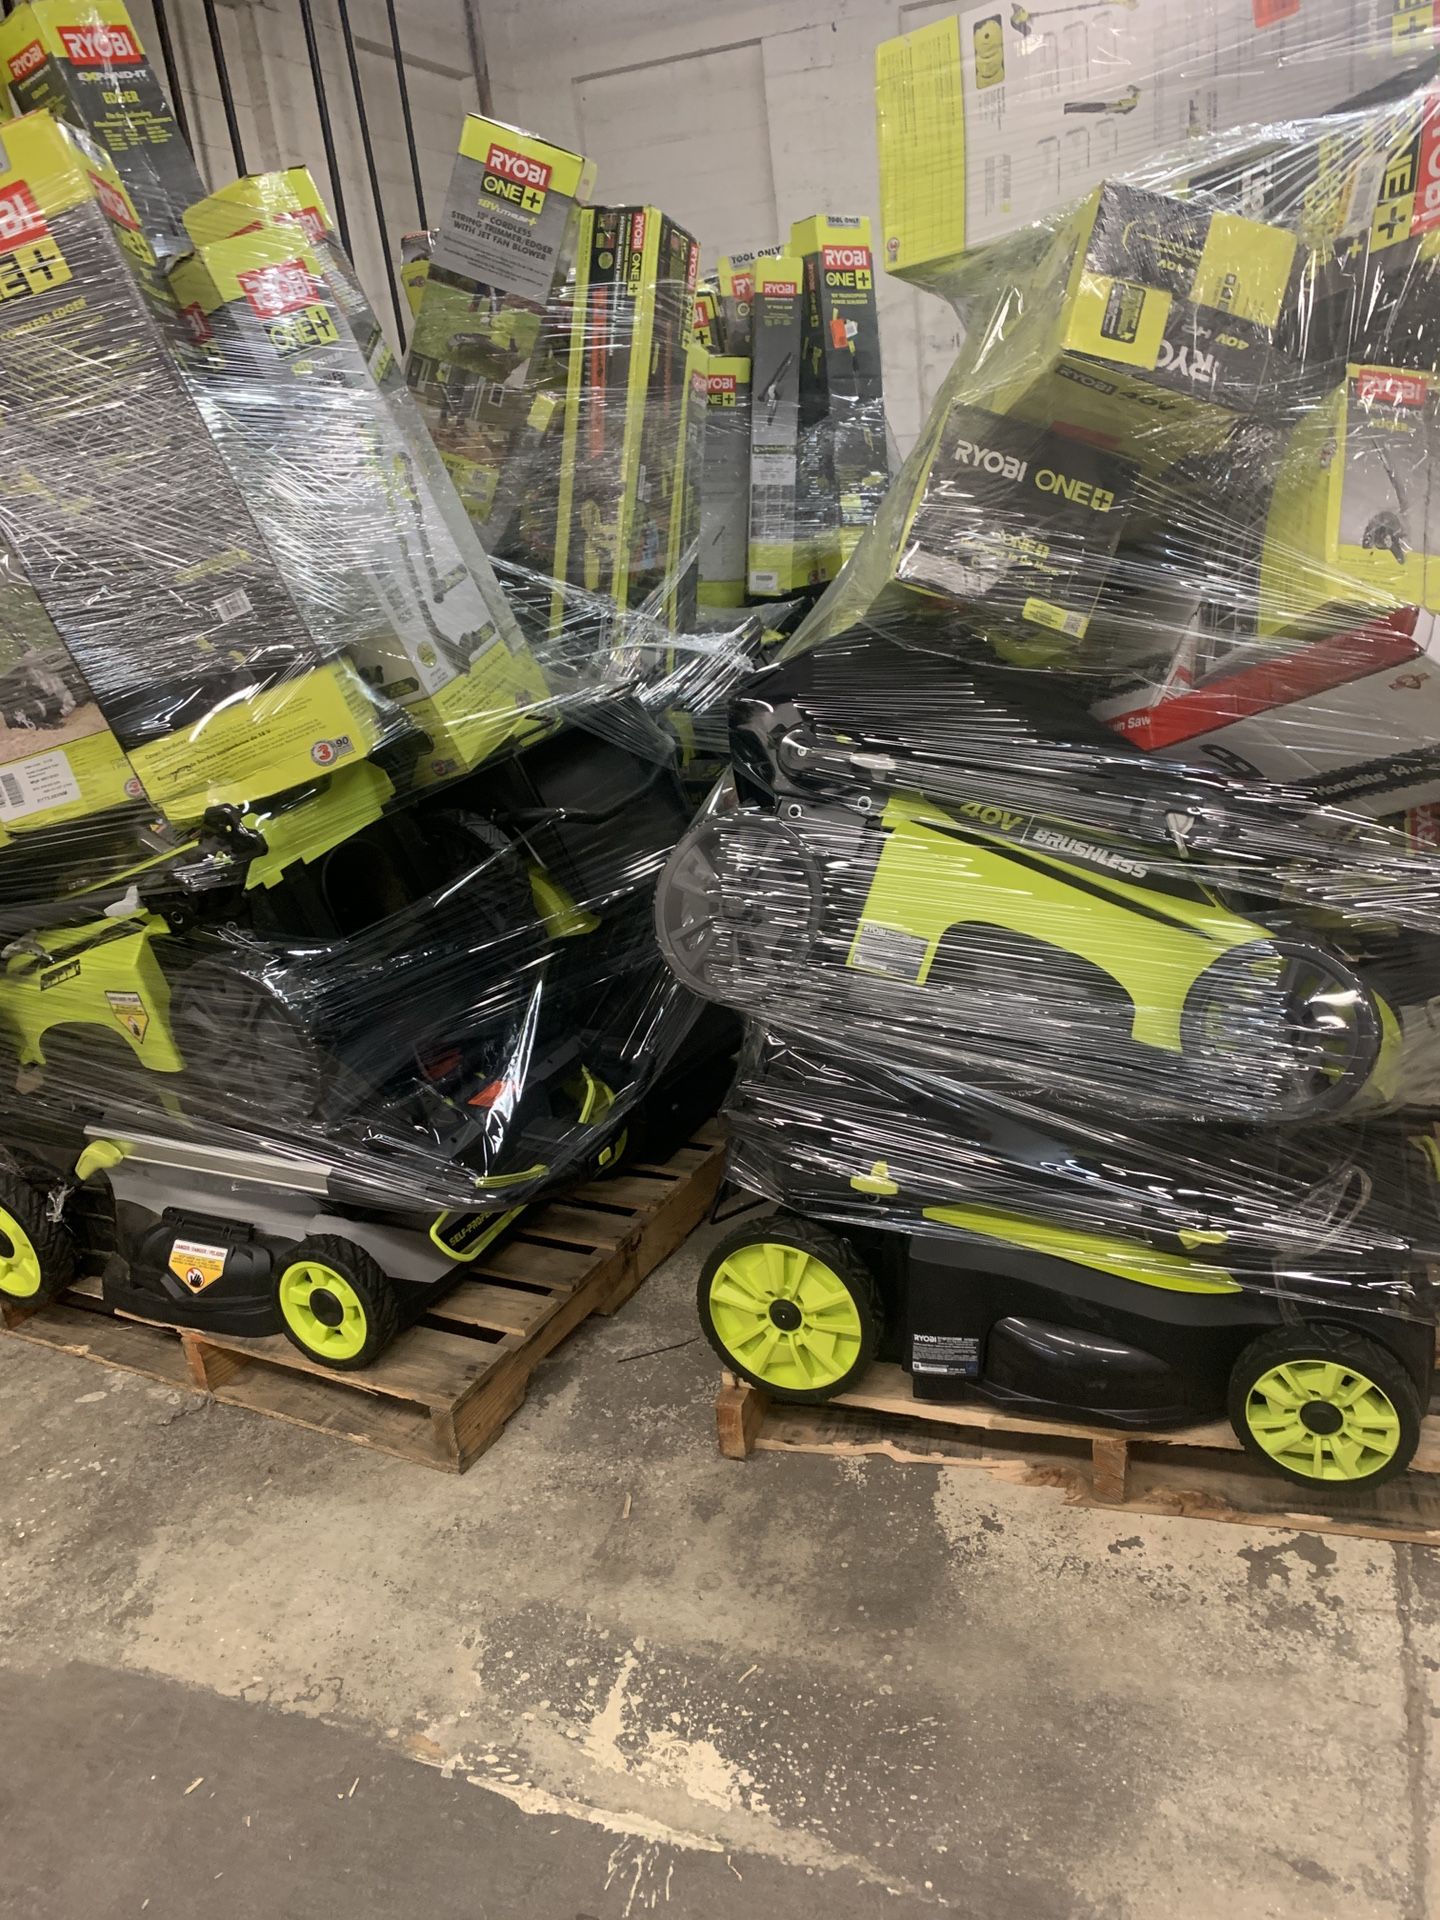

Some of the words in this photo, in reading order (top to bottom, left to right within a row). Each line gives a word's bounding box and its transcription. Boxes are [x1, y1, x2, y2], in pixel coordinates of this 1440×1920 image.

[64, 31, 136, 58] RYOBI
[10, 44, 44, 77] RYOBI
[490, 148, 548, 187] RYOBI
[482, 174, 546, 215] ONE+
[451, 210, 482, 228] STRING
[490, 216, 532, 238] CORDLESS
[827, 216, 843, 224] TOOL
[453, 220, 476, 235] WITH
[477, 229, 491, 241] JET
[493, 234, 510, 248] FAN
[511, 243, 547, 261] BLOWER
[633, 213, 644, 249] RYOBI
[731, 253, 755, 265] TOOL
[757, 246, 782, 258] ONLY
[825, 249, 867, 267] RYOBI
[627, 252, 642, 297] ONE+
[688, 245, 698, 292] RYOBI
[764, 283, 795, 294] RYOBI
[826, 269, 872, 290] ONE+
[1215, 332, 1250, 351] 40V
[707, 378, 734, 388] YOBI
[1060, 366, 1114, 395] RYOBI
[707, 392, 736, 407] NE+
[954, 439, 1028, 482] RYOBI
[1034, 468, 1115, 513] ONE+
[1126, 713, 1151, 731] Saw
[335, 736, 349, 748] 90
[1389, 763, 1411, 777] 14
[959, 801, 1024, 831] 40V
[1032, 828, 1150, 879] BRUSHLESS
[913, 1333, 937, 1343] RYOBI
